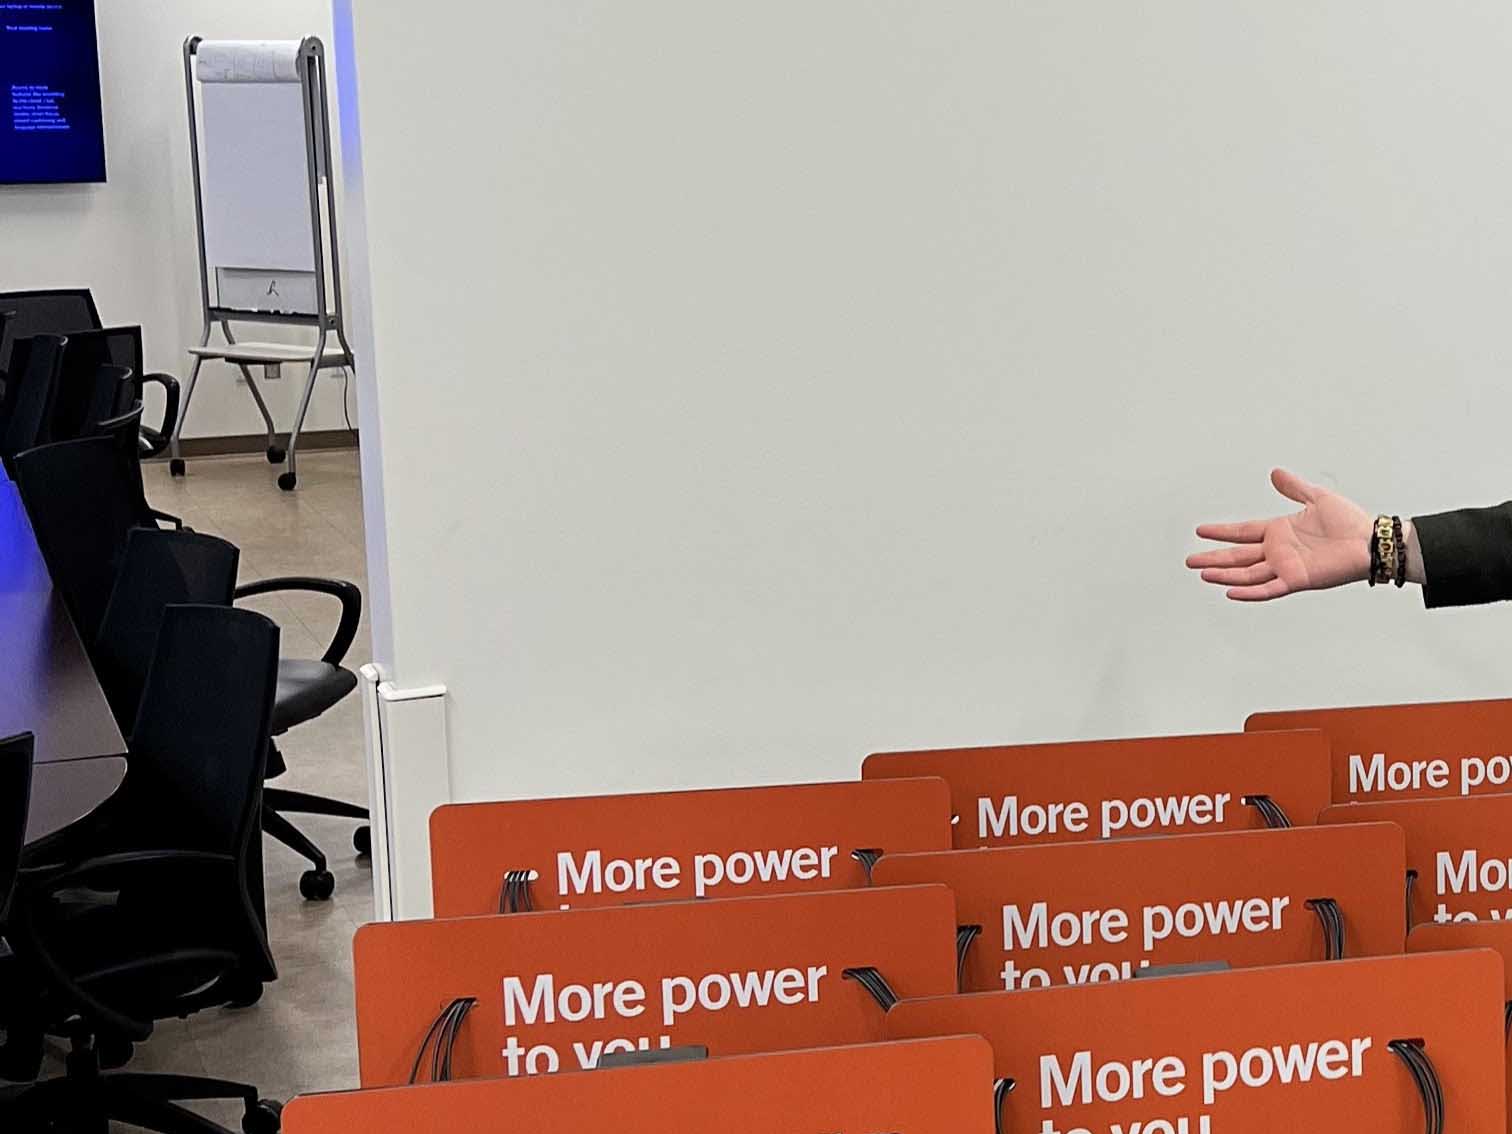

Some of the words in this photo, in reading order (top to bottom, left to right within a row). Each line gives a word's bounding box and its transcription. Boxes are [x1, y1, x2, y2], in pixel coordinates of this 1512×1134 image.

[1349, 753, 1450, 793] More
[978, 796, 1089, 838] More
[1101, 793, 1231, 838] power
[557, 850, 681, 895] More
[694, 846, 838, 897] power
[1003, 902, 1129, 951] More
[1143, 896, 1290, 951] power
[503, 974, 646, 1026] More
[661, 965, 827, 1026] power
[502, 1036, 560, 1076] to
[1039, 1051, 1186, 1108] More
[1202, 1037, 1372, 1105] power
